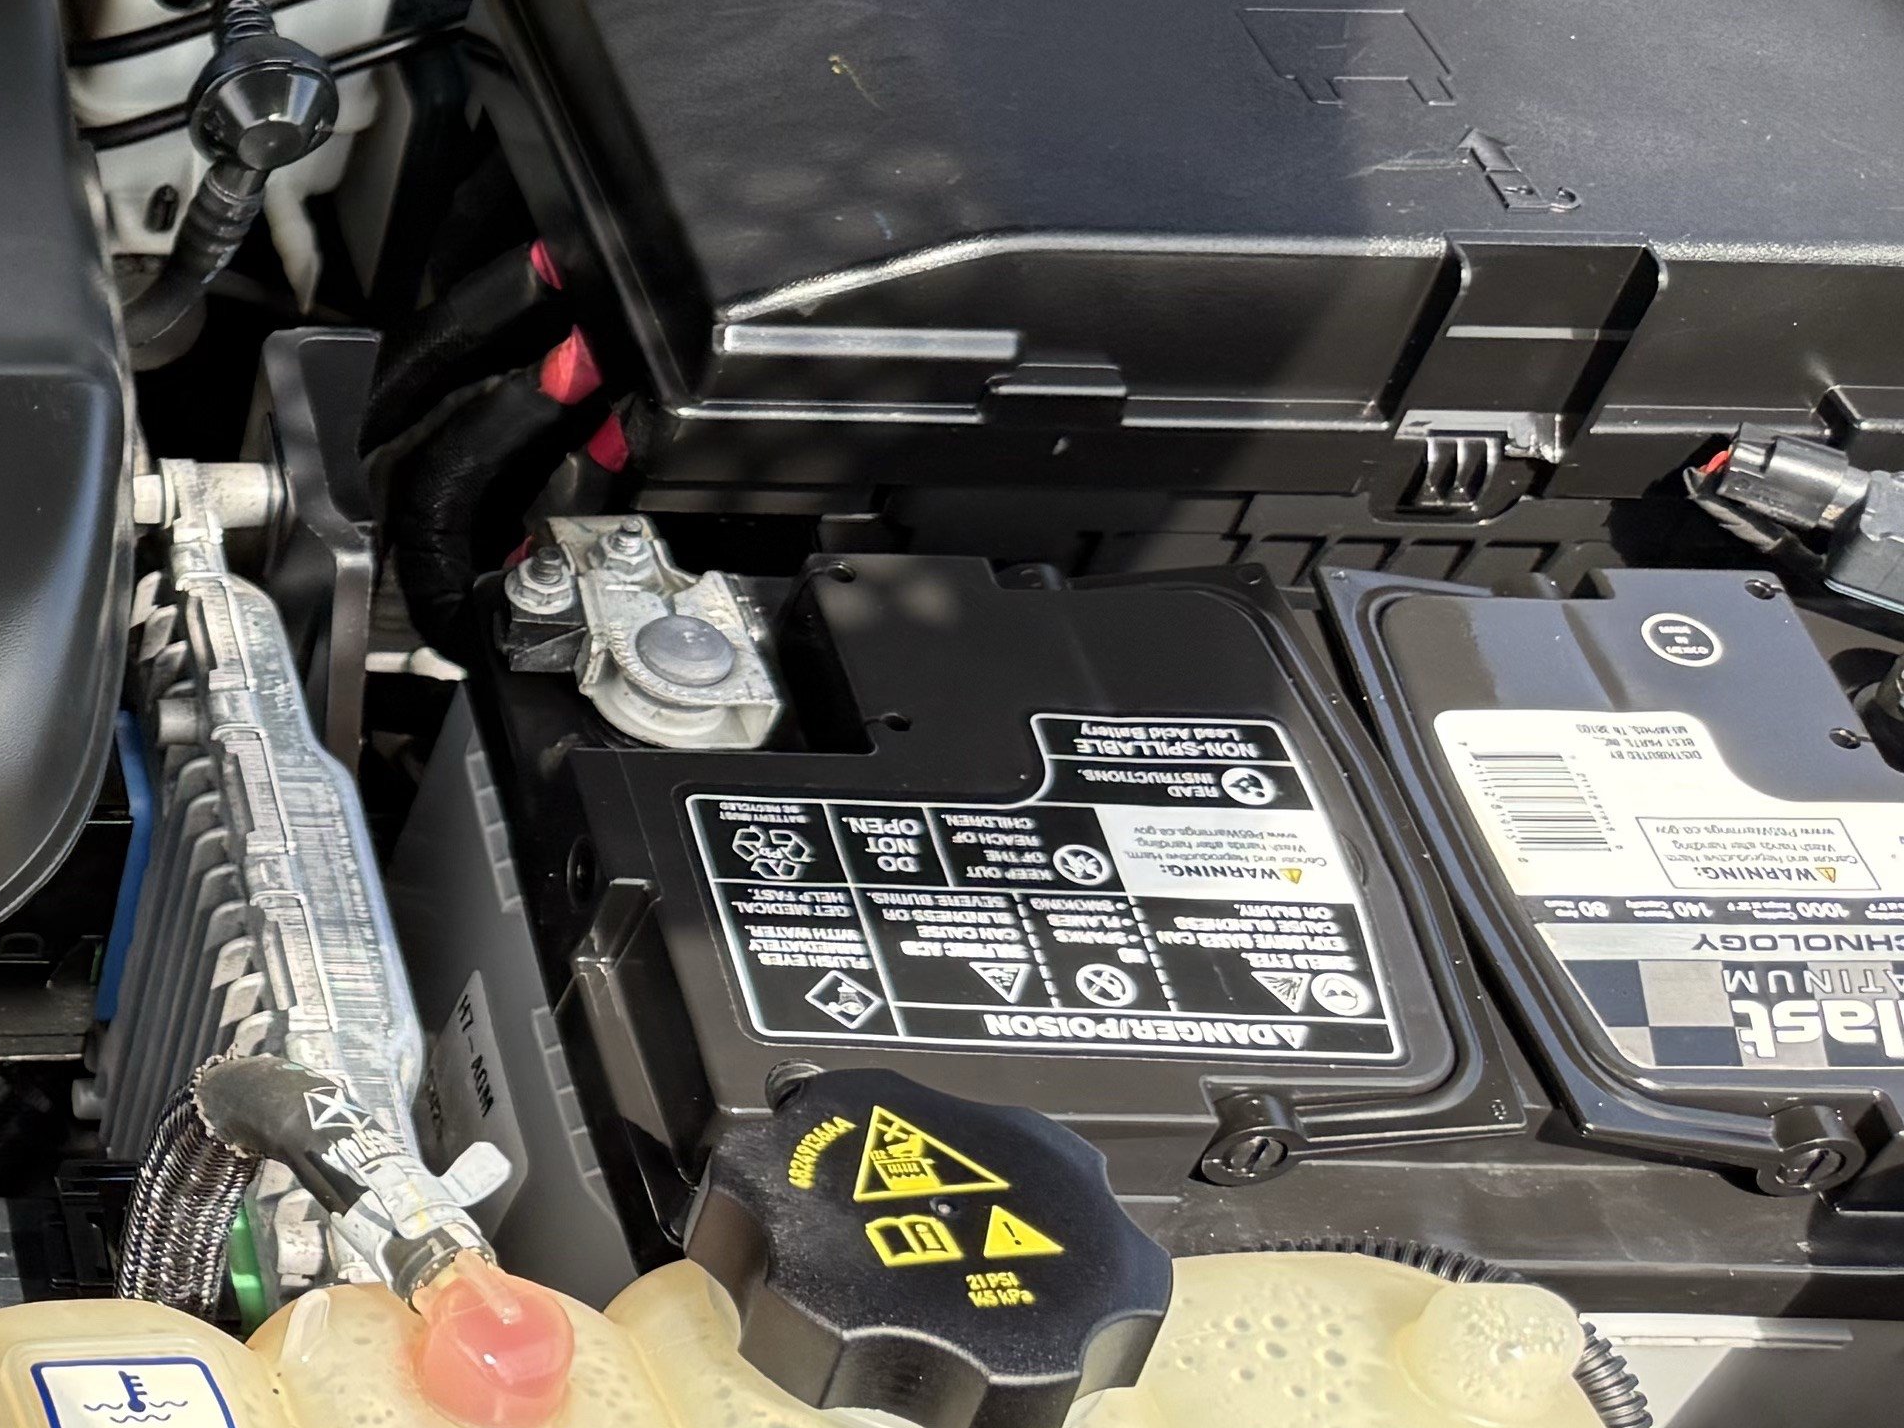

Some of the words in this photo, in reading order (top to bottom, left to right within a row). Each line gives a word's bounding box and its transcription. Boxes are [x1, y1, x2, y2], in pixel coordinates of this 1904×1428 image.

[1147, 726, 1191, 739] Acid
[1073, 738, 1257, 758] NON-SPILLABLE
[1077, 768, 1214, 785] INSTRUCTIONS.
[1166, 783, 1218, 798] READ
[841, 816, 918, 836] OPEN.
[865, 836, 918, 854] NOT
[876, 855, 920, 873] DO
[966, 865, 999, 879] OUT
[1159, 864, 1281, 881] WARNING:
[1694, 867, 1818, 881] WARNING:
[1578, 901, 1610, 918] 80
[1673, 901, 1714, 919] 140
[1795, 901, 1851, 919] 1000
[1156, 930, 1194, 946] CAN
[983, 1012, 1279, 1046] DANGER/POISON
[1731, 999, 1904, 1059] last
[966, 1274, 988, 1291] 21
[985, 1271, 1020, 1289] PSI
